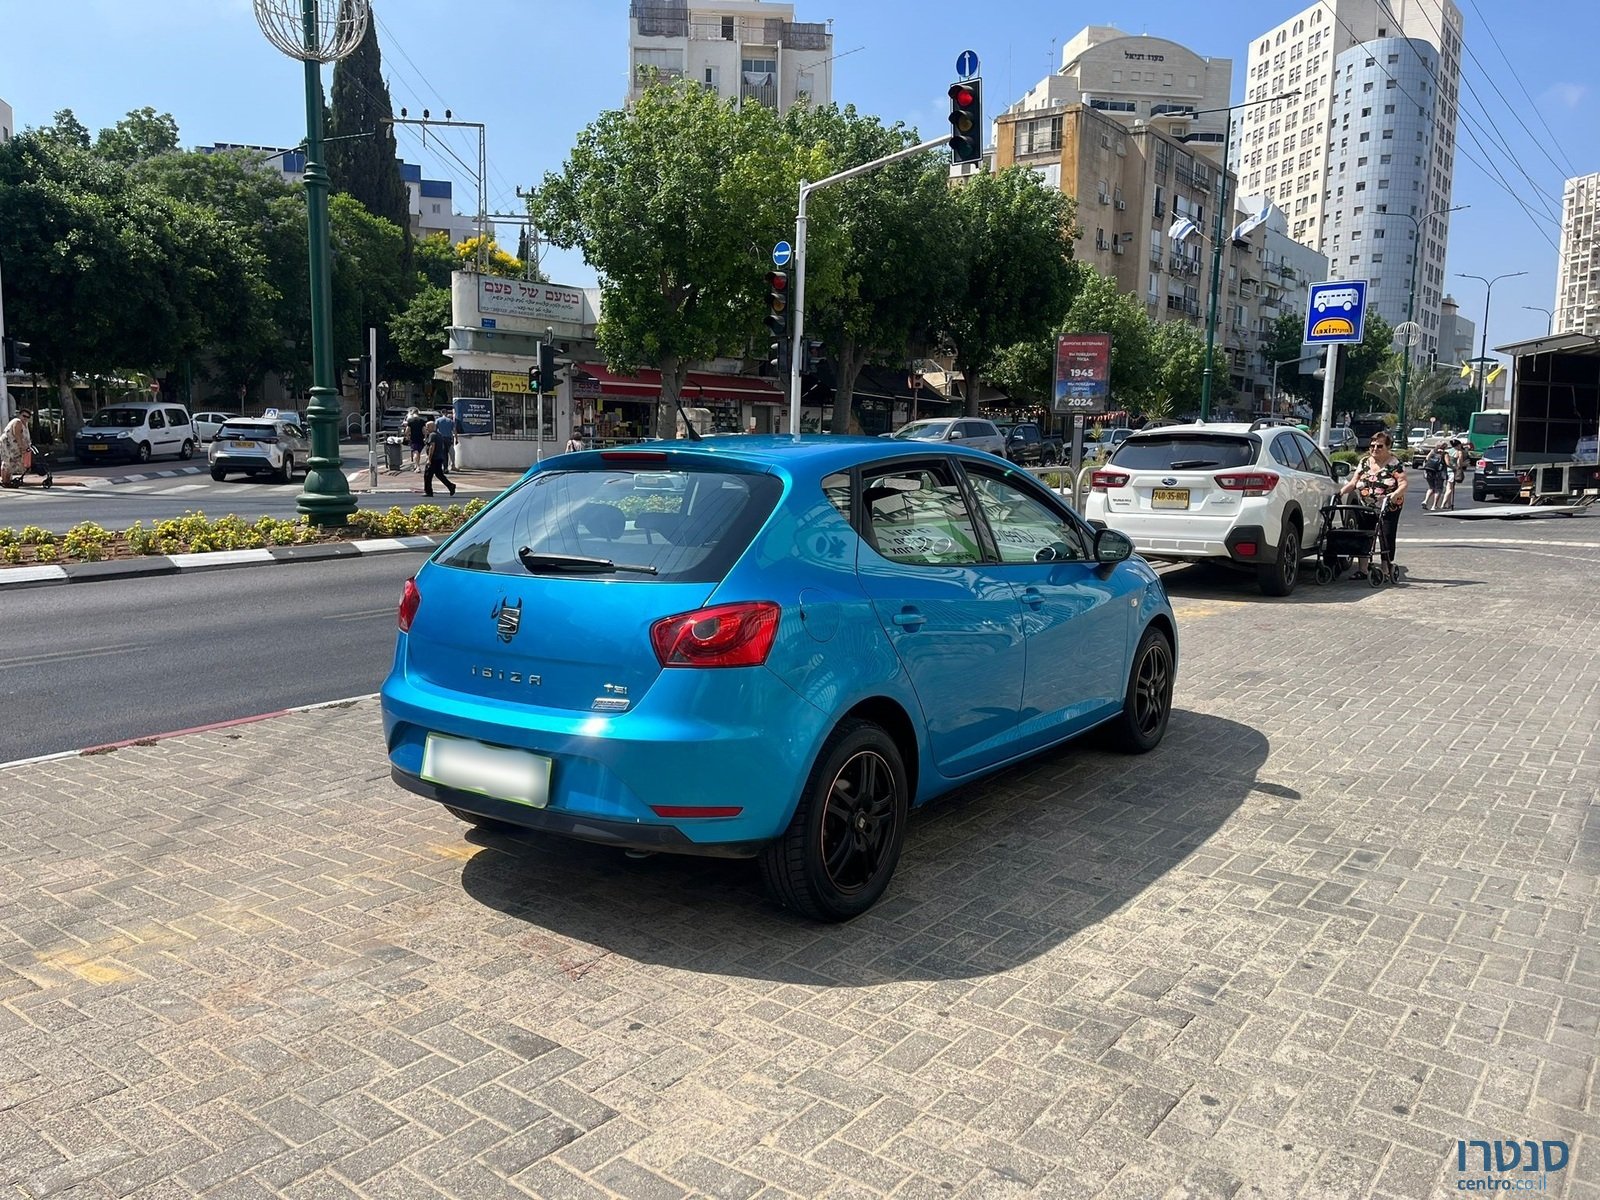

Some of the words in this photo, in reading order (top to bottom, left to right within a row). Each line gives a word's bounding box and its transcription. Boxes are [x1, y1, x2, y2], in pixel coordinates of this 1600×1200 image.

[484, 281, 512, 295] פעם
[518, 283, 539, 298] של
[545, 290, 579, 304] בטעם
[1070, 368, 1094, 377] 1945
[1068, 398, 1094, 407] 2024
